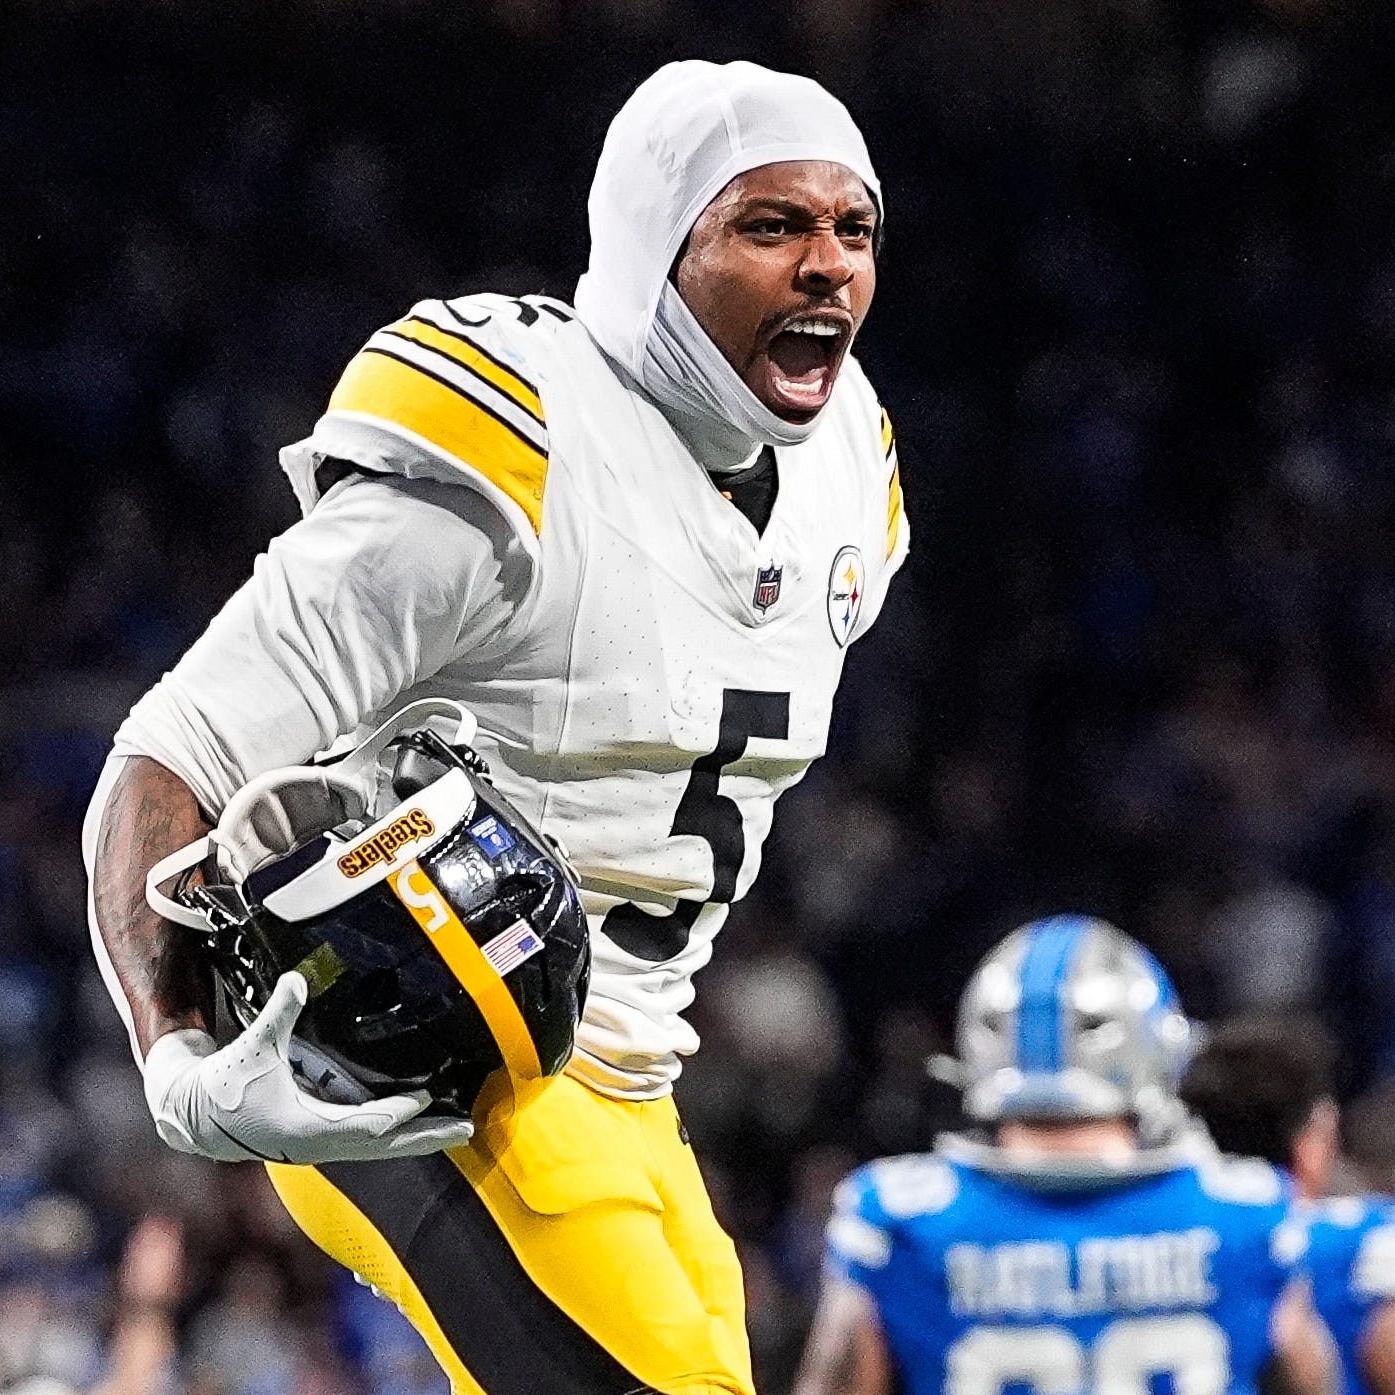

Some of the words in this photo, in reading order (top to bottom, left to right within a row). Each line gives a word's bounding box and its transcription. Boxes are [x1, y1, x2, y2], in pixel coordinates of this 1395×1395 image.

[759, 584, 778, 605] NFL
[337, 808, 435, 878] Steelers
[600, 688, 791, 962] 5
[397, 864, 450, 934] 5
